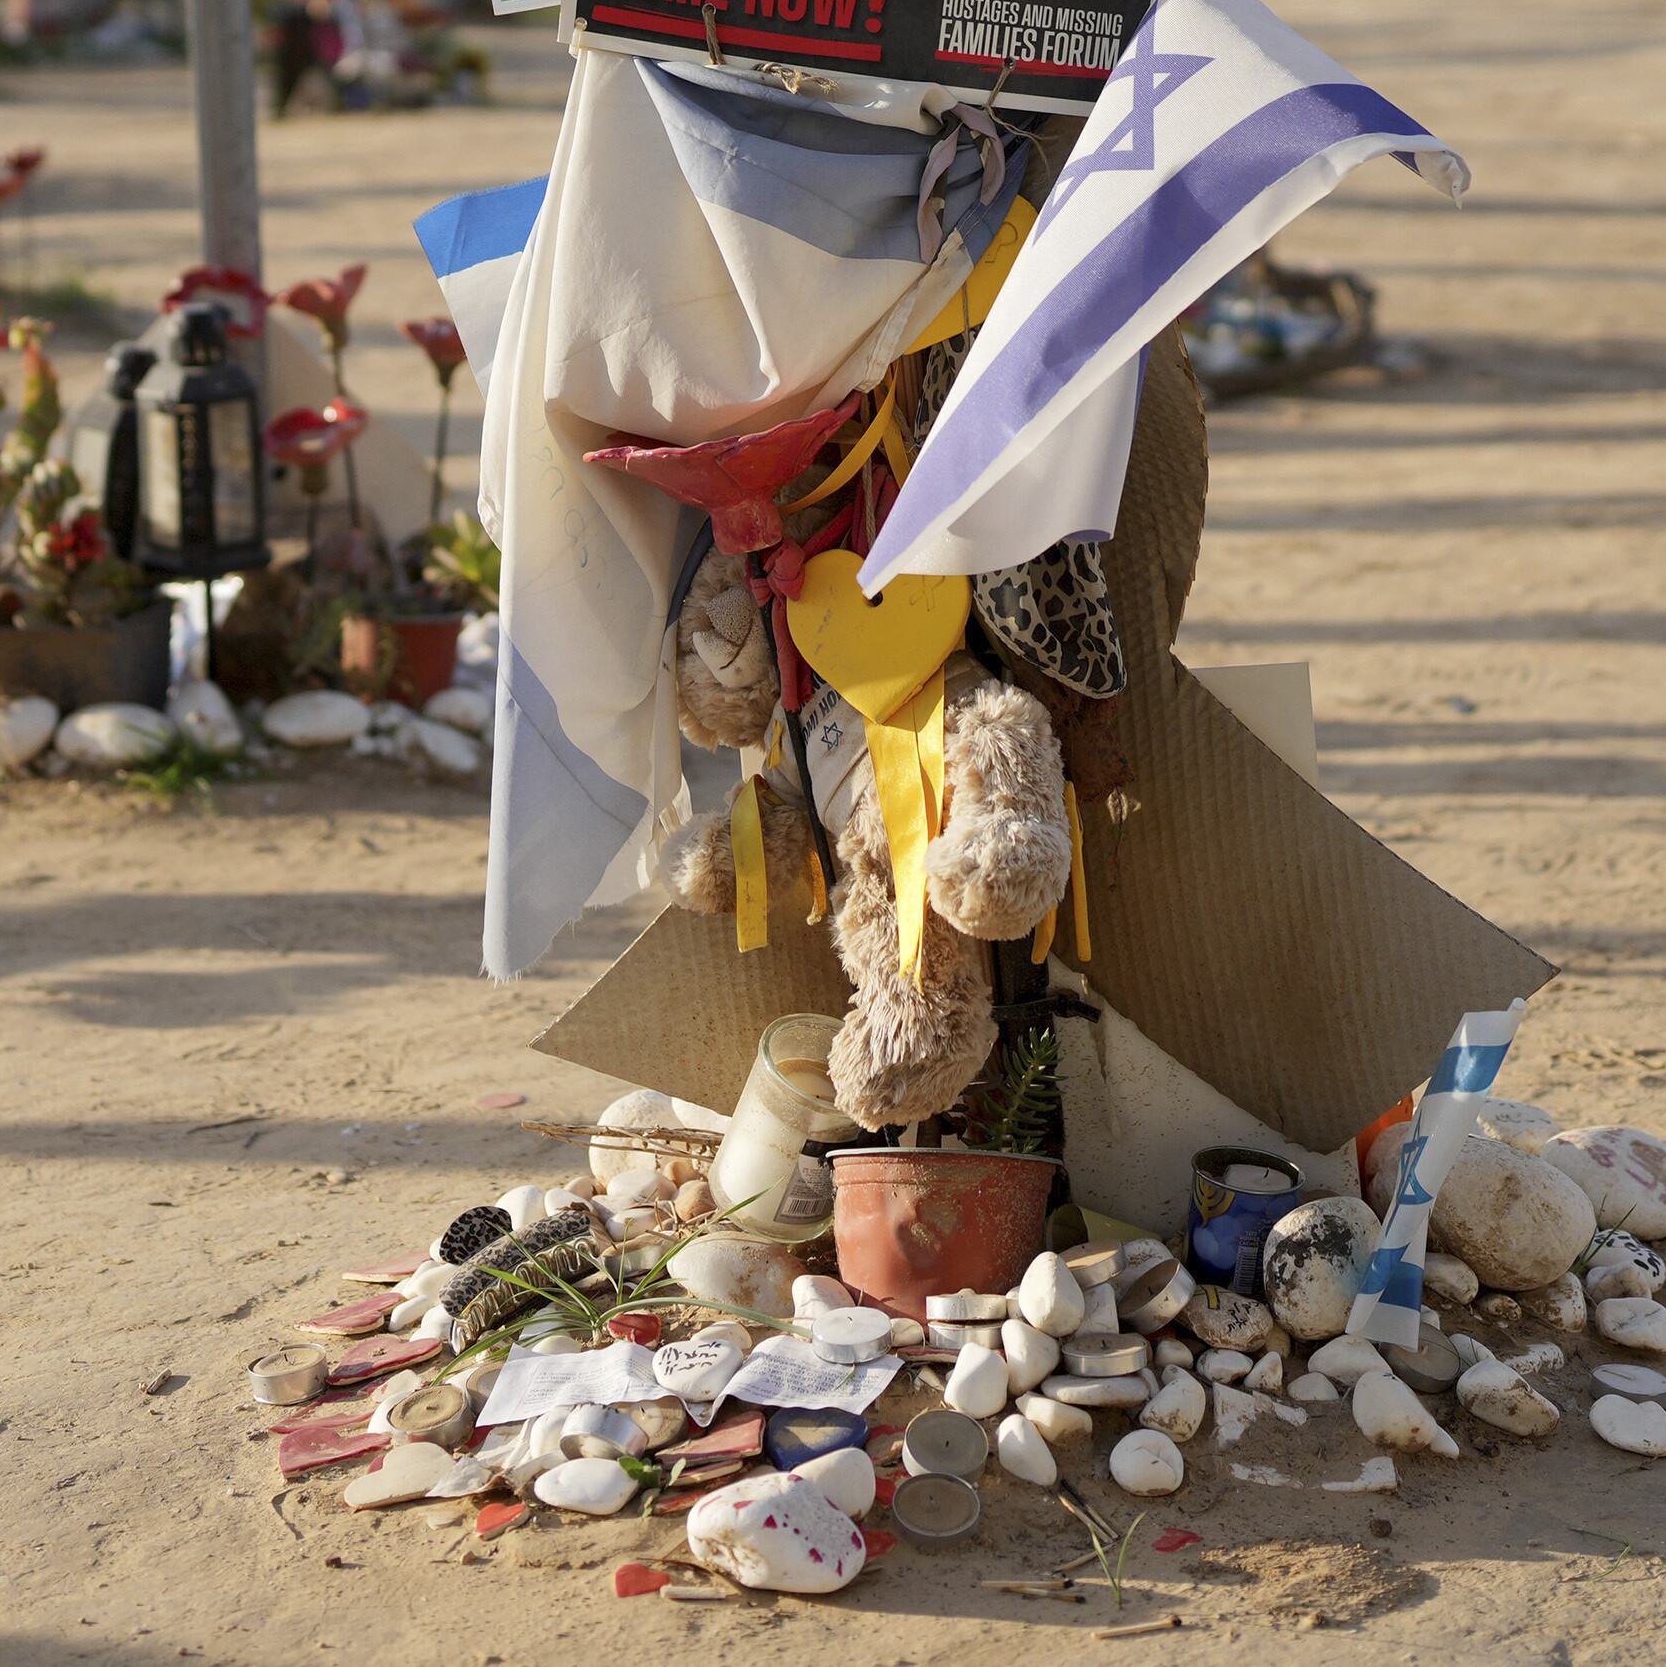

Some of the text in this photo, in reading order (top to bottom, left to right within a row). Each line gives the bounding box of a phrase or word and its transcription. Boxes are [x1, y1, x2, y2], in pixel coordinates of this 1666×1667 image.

[1021, 3, 1054, 29] AND
[1055, 7, 1124, 37] MISSING
[938, 18, 1121, 71] FAMILIES FORUM
